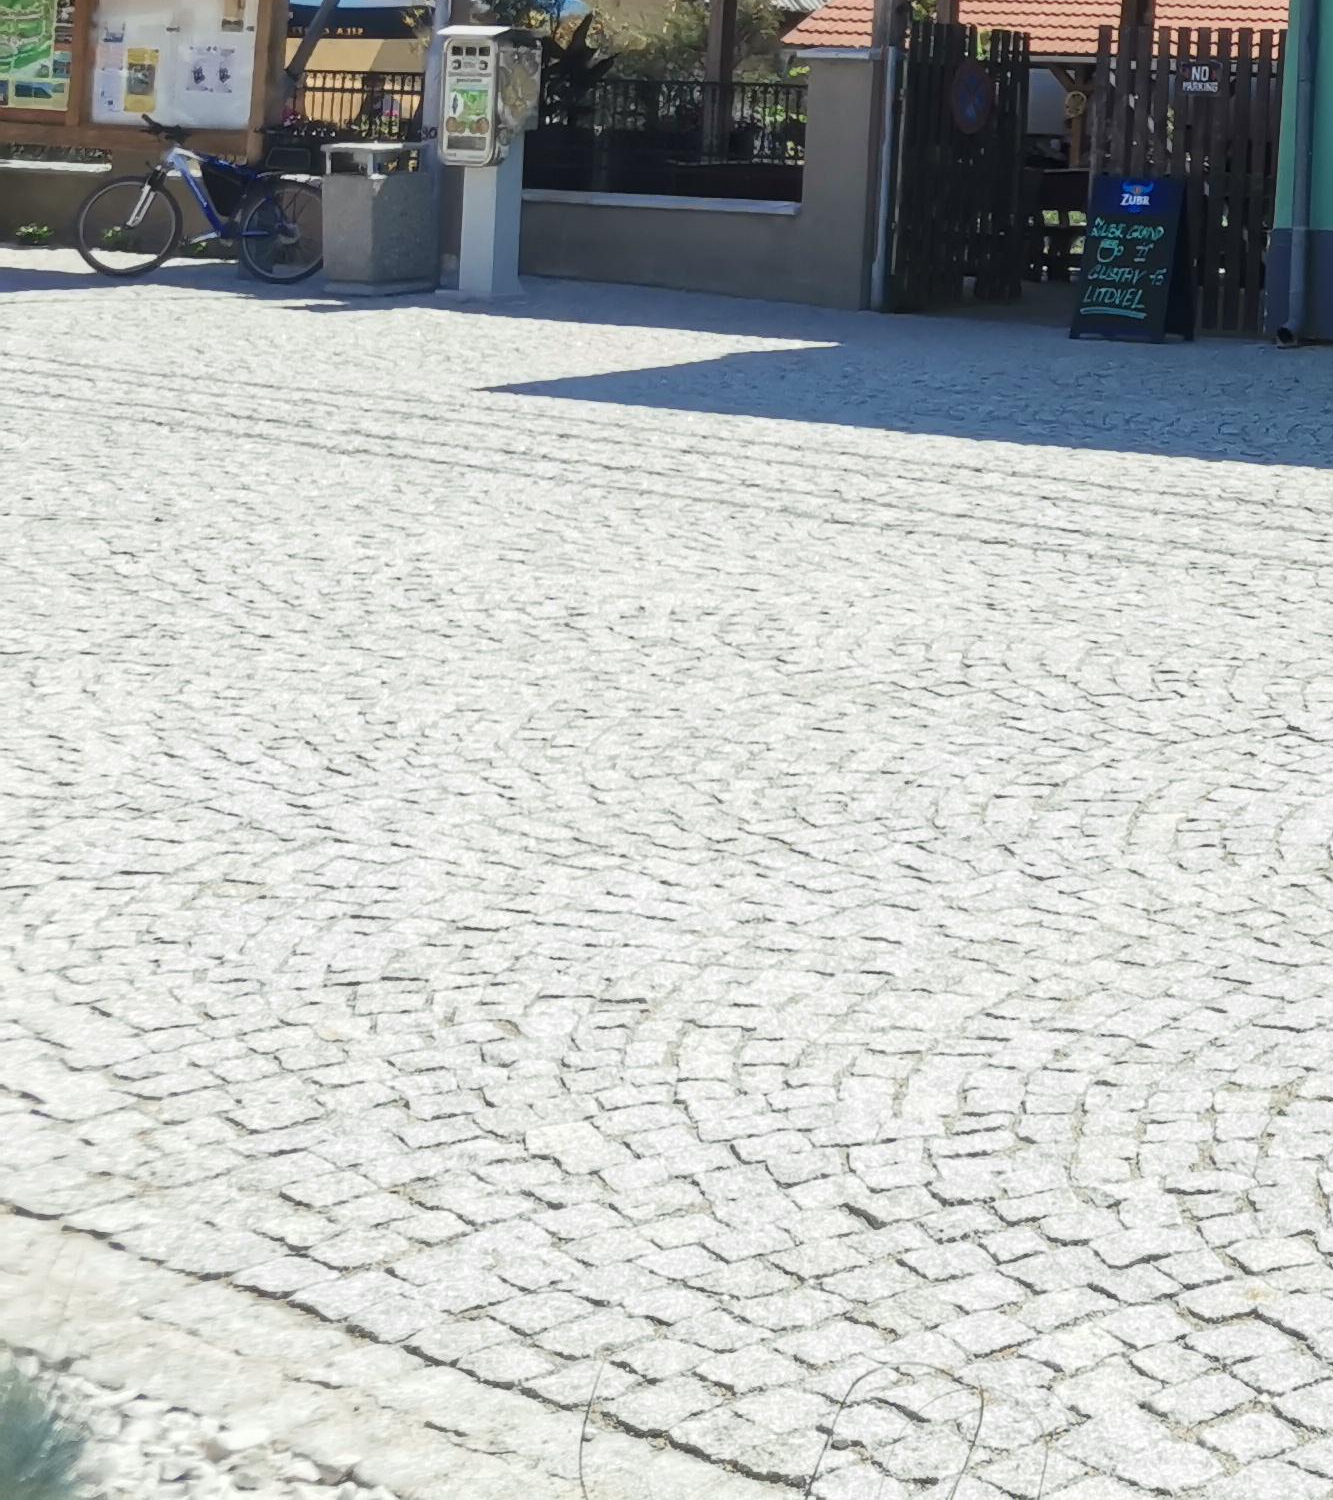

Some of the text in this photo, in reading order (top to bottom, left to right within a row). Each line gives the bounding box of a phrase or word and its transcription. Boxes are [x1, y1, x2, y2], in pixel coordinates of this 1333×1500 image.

[1191, 66, 1210, 81] NO
[1182, 81, 1219, 92] PARKING
[1120, 193, 1150, 206] ZUBR
[1087, 265, 1145, 285] GUSTAV
[1082, 285, 1146, 309] LITOVEL
